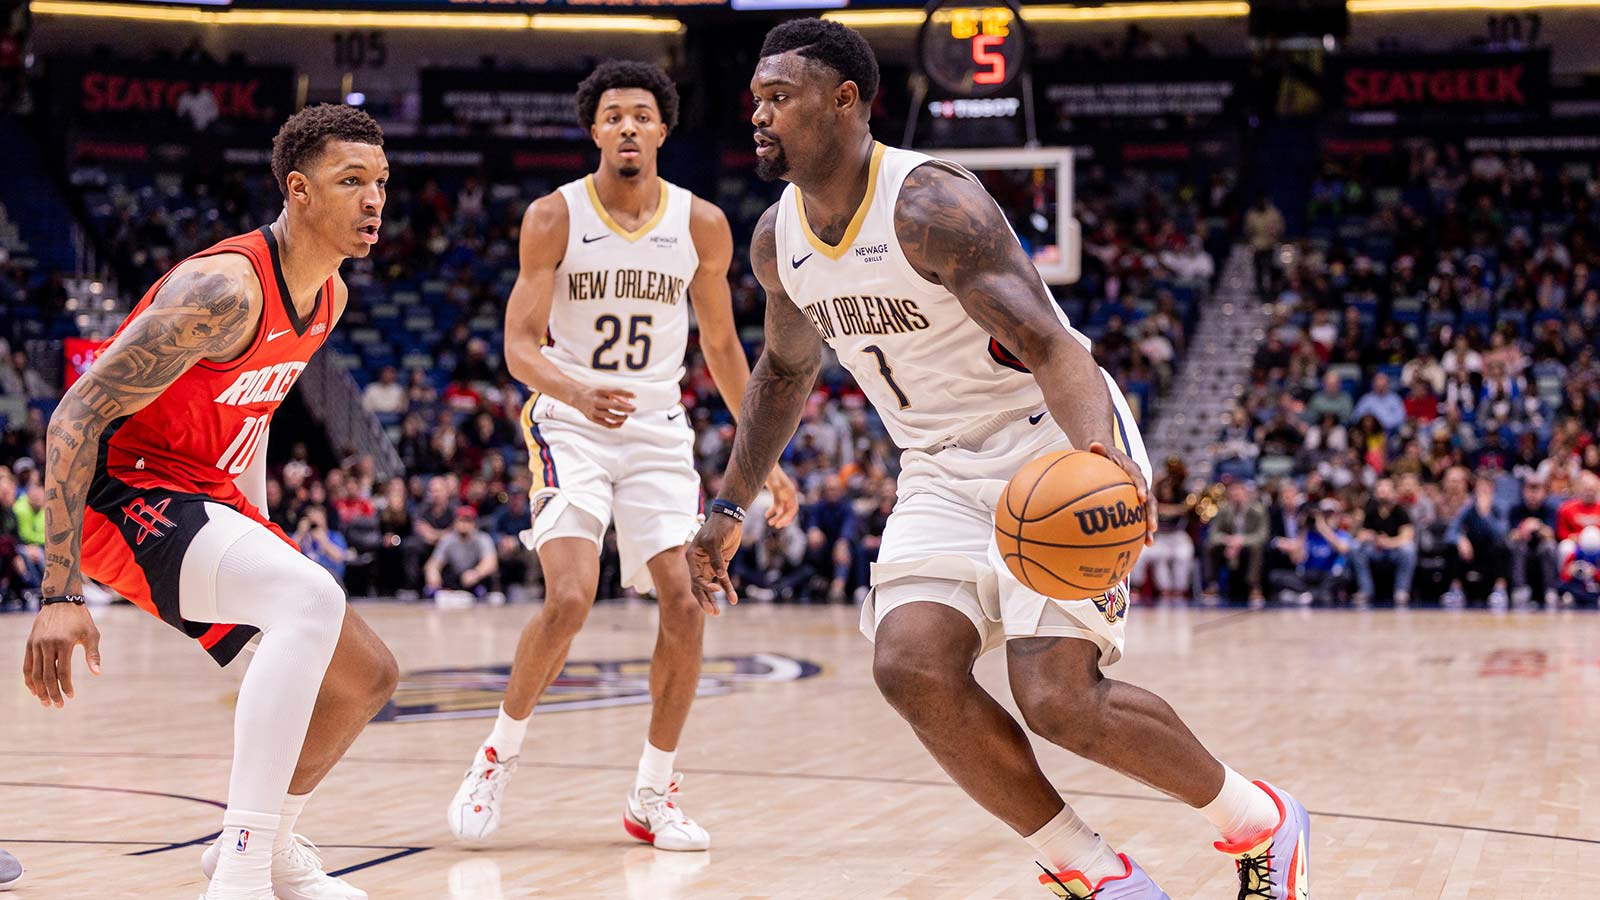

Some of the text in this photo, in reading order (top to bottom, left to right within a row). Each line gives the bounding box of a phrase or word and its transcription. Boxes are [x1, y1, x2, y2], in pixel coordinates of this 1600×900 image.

[333, 31, 386, 66] 105
[972, 34, 1006, 85] 5
[81, 73, 259, 116] SEATGEK
[855, 243, 889, 257] NEWAGE
[864, 255, 883, 263] GRILLS
[568, 269, 684, 306] NEW ORLEANS
[833, 295, 931, 336] ORLEANS
[592, 313, 653, 373] 25
[861, 344, 912, 410] 1
[216, 414, 269, 474] 10
